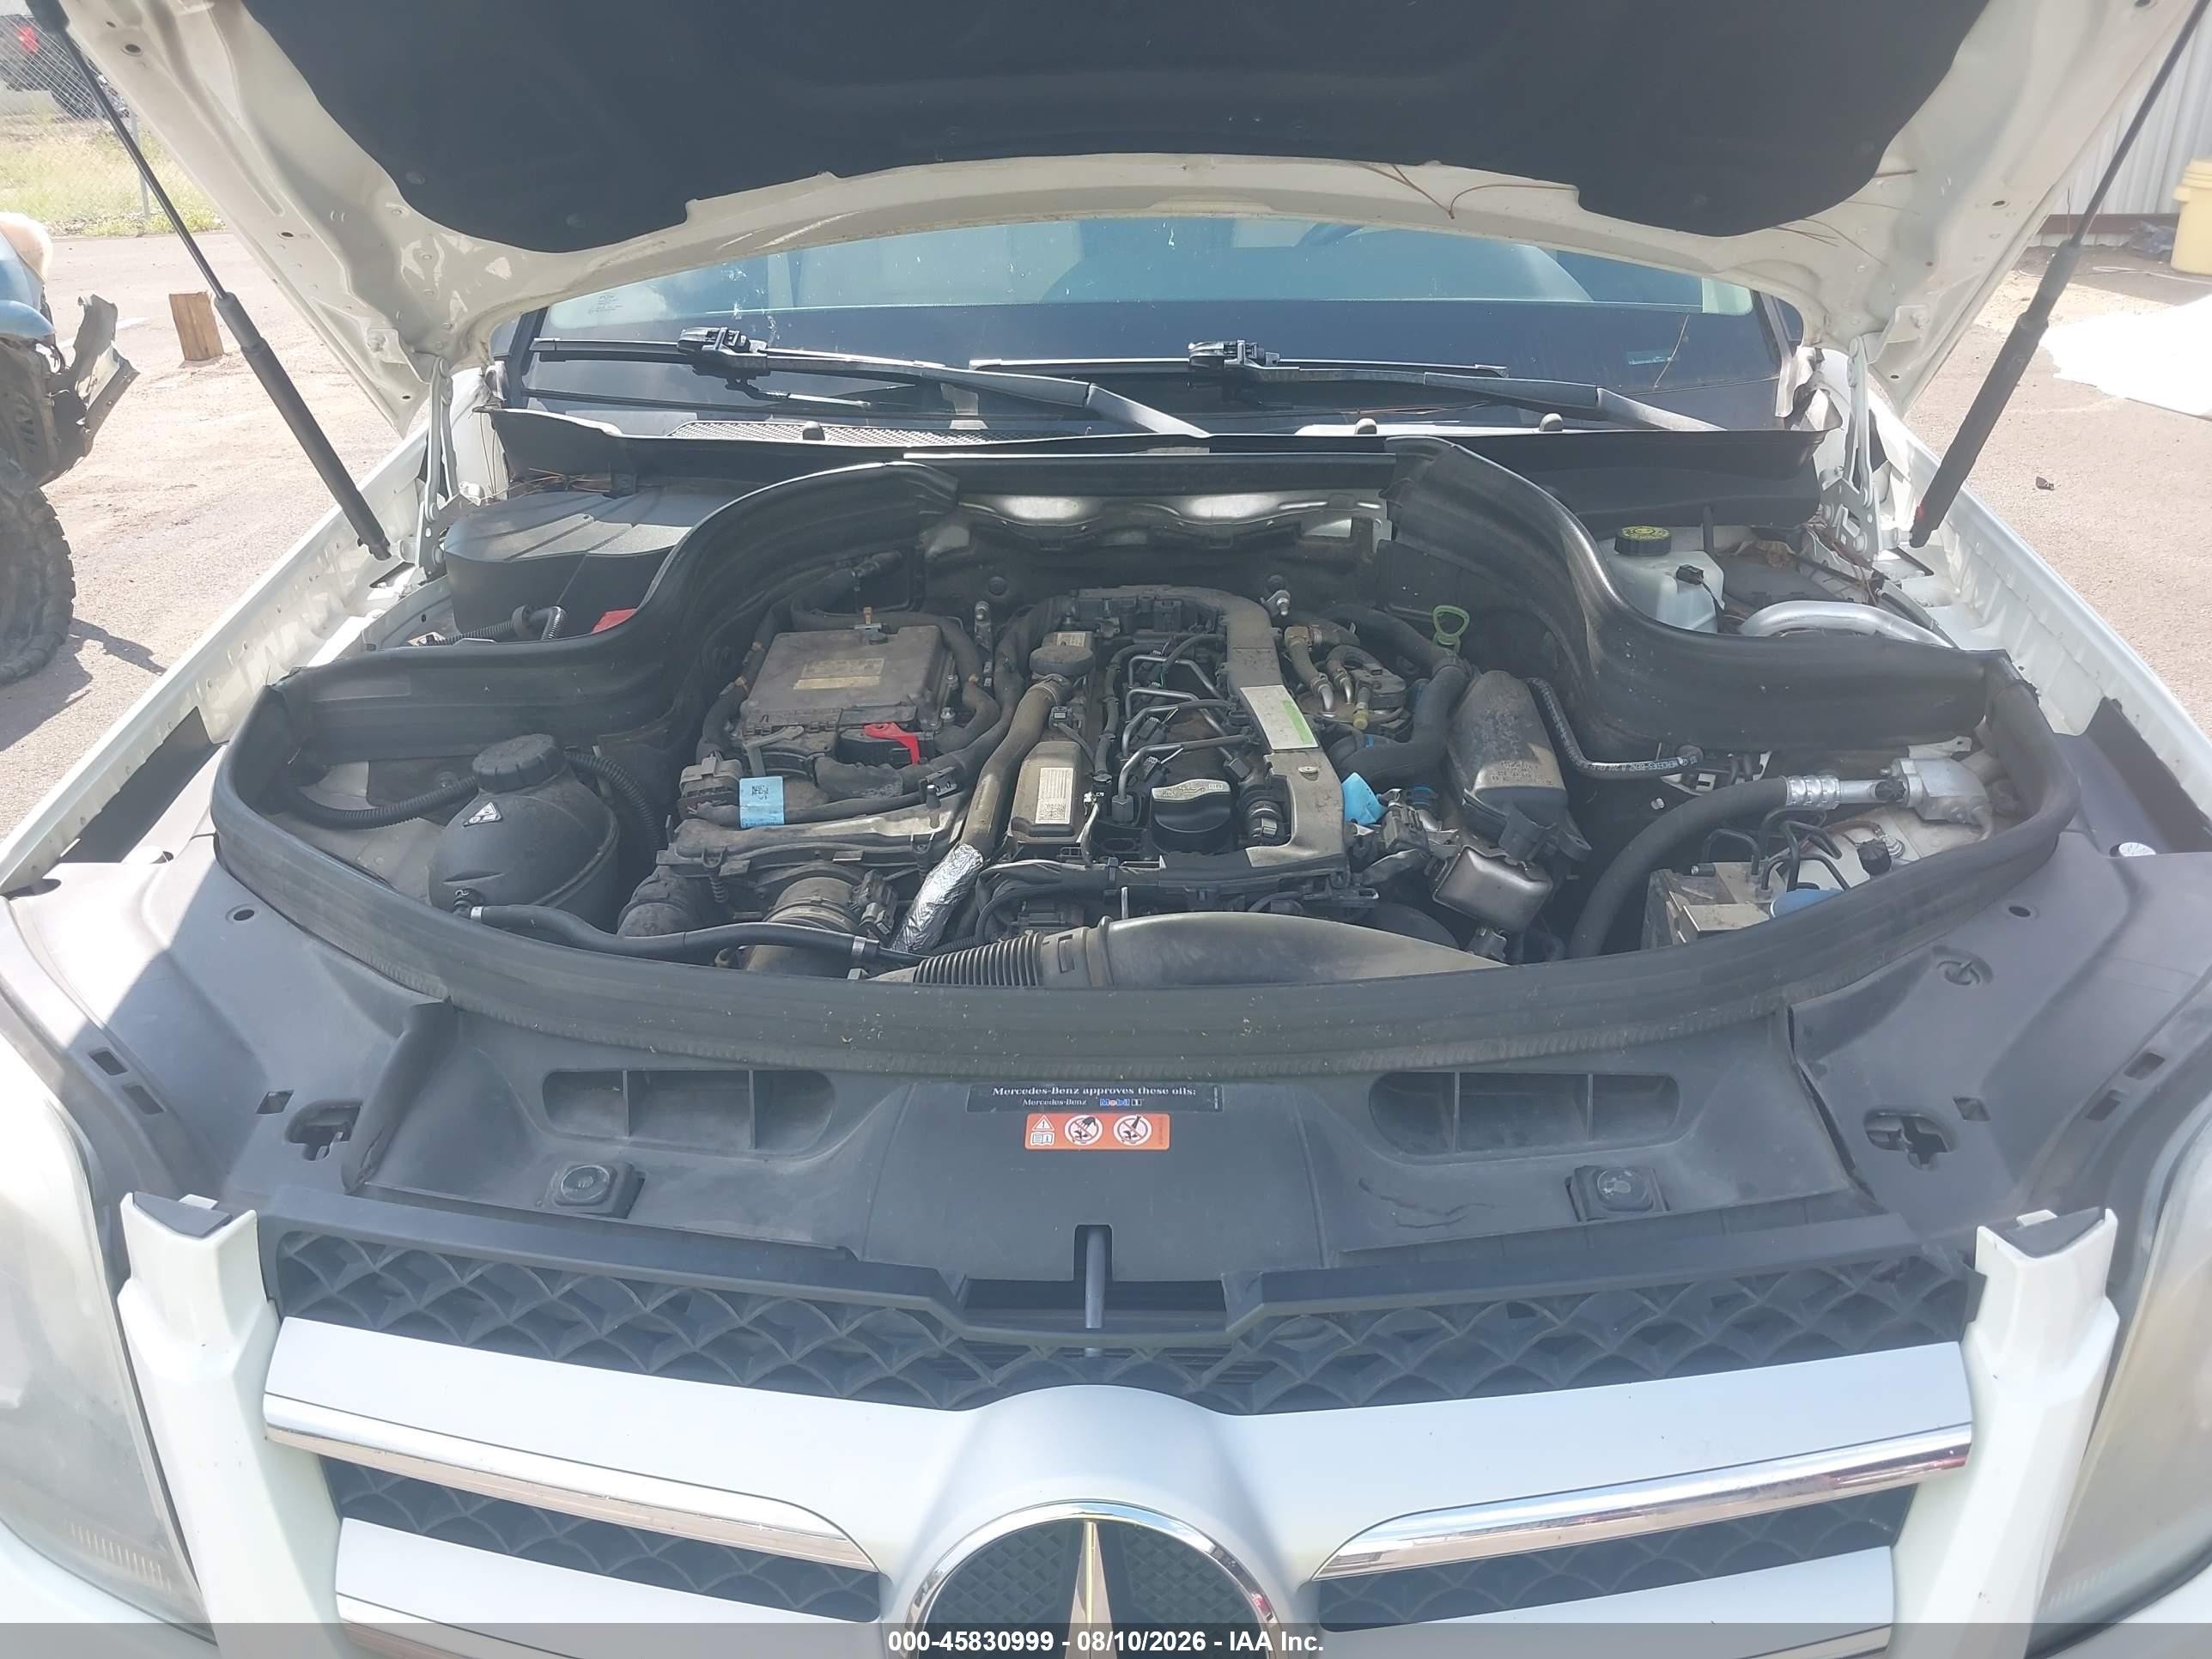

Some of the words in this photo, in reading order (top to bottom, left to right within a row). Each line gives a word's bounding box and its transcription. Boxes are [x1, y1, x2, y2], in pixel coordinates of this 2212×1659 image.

[993, 1086, 1079, 1096] Mercedes-Benz
[1083, 1086, 1134, 1097] approves
[1138, 1086, 1170, 1095] these
[1171, 1086, 1196, 1096] oils:
[1022, 1097, 1087, 1106] Mercedes-Benz
[1099, 1097, 1130, 1106] Mobil
